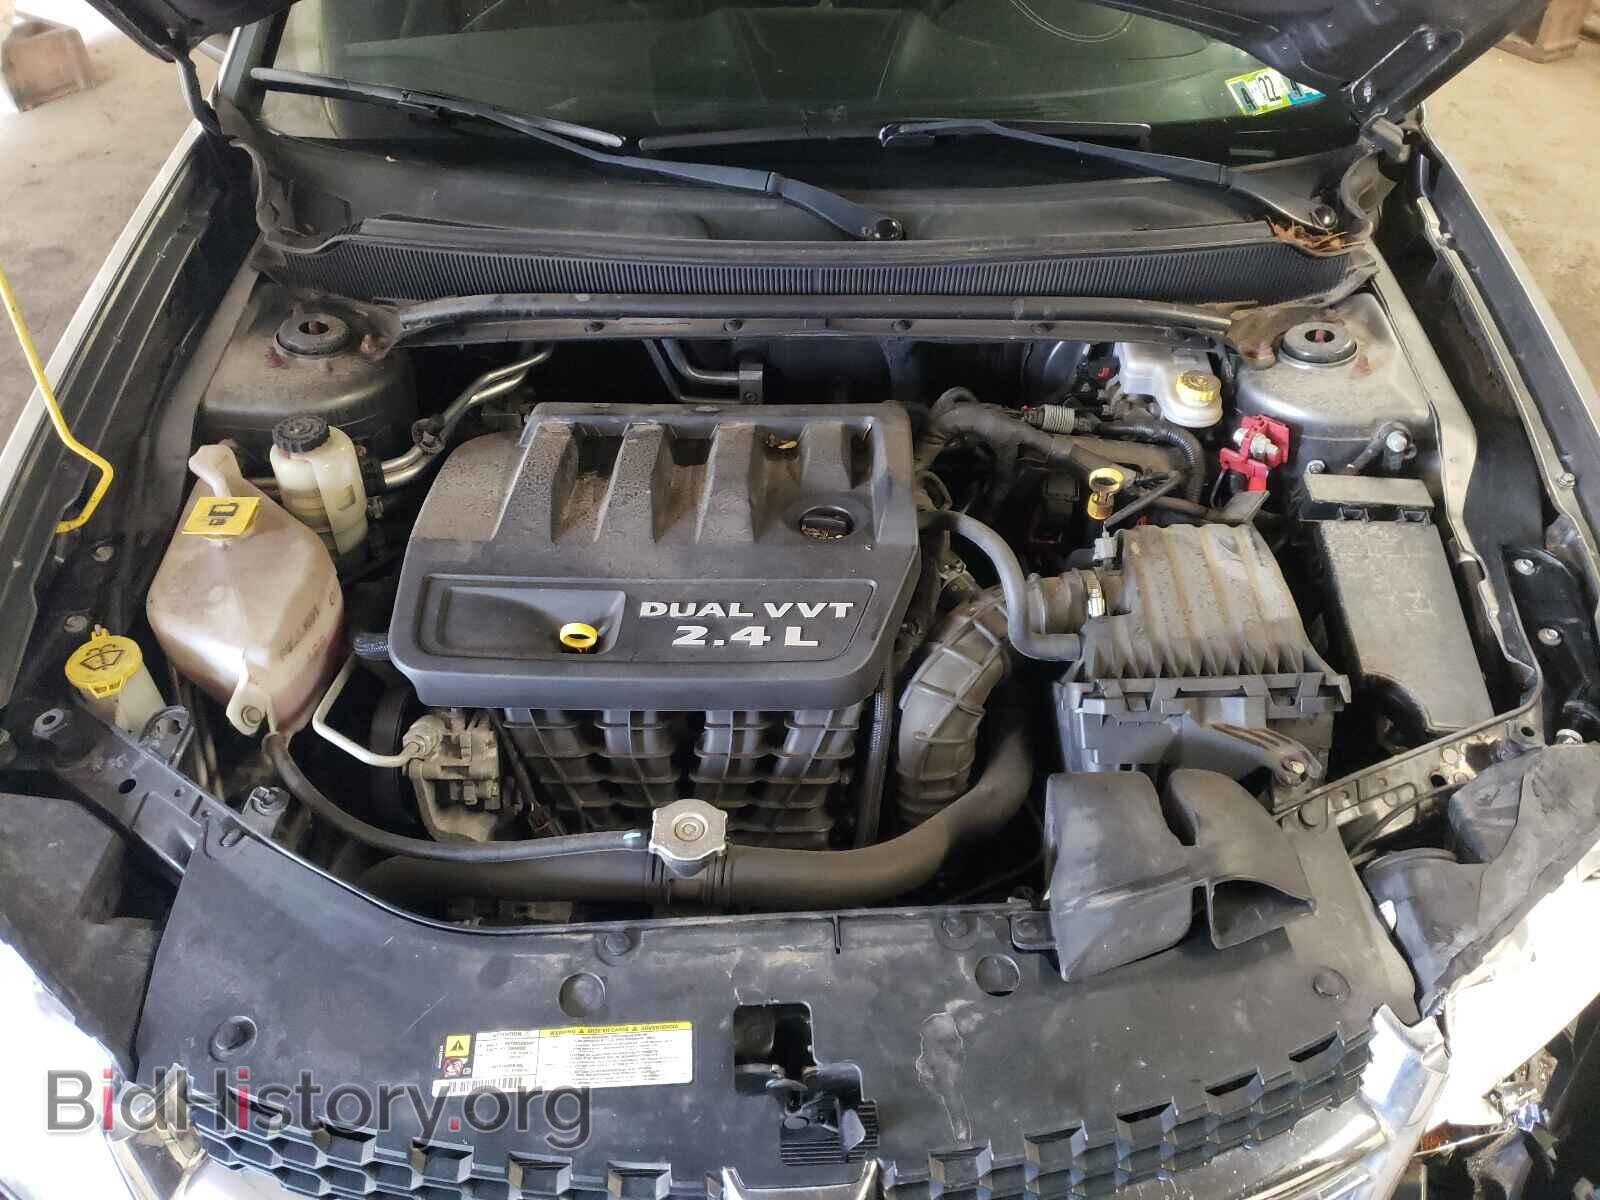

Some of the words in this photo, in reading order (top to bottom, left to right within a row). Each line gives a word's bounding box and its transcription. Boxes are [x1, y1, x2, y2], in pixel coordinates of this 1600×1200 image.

[1258, 75, 1282, 102] 22
[640, 602, 754, 618] DUAL
[764, 602, 854, 619] VVT
